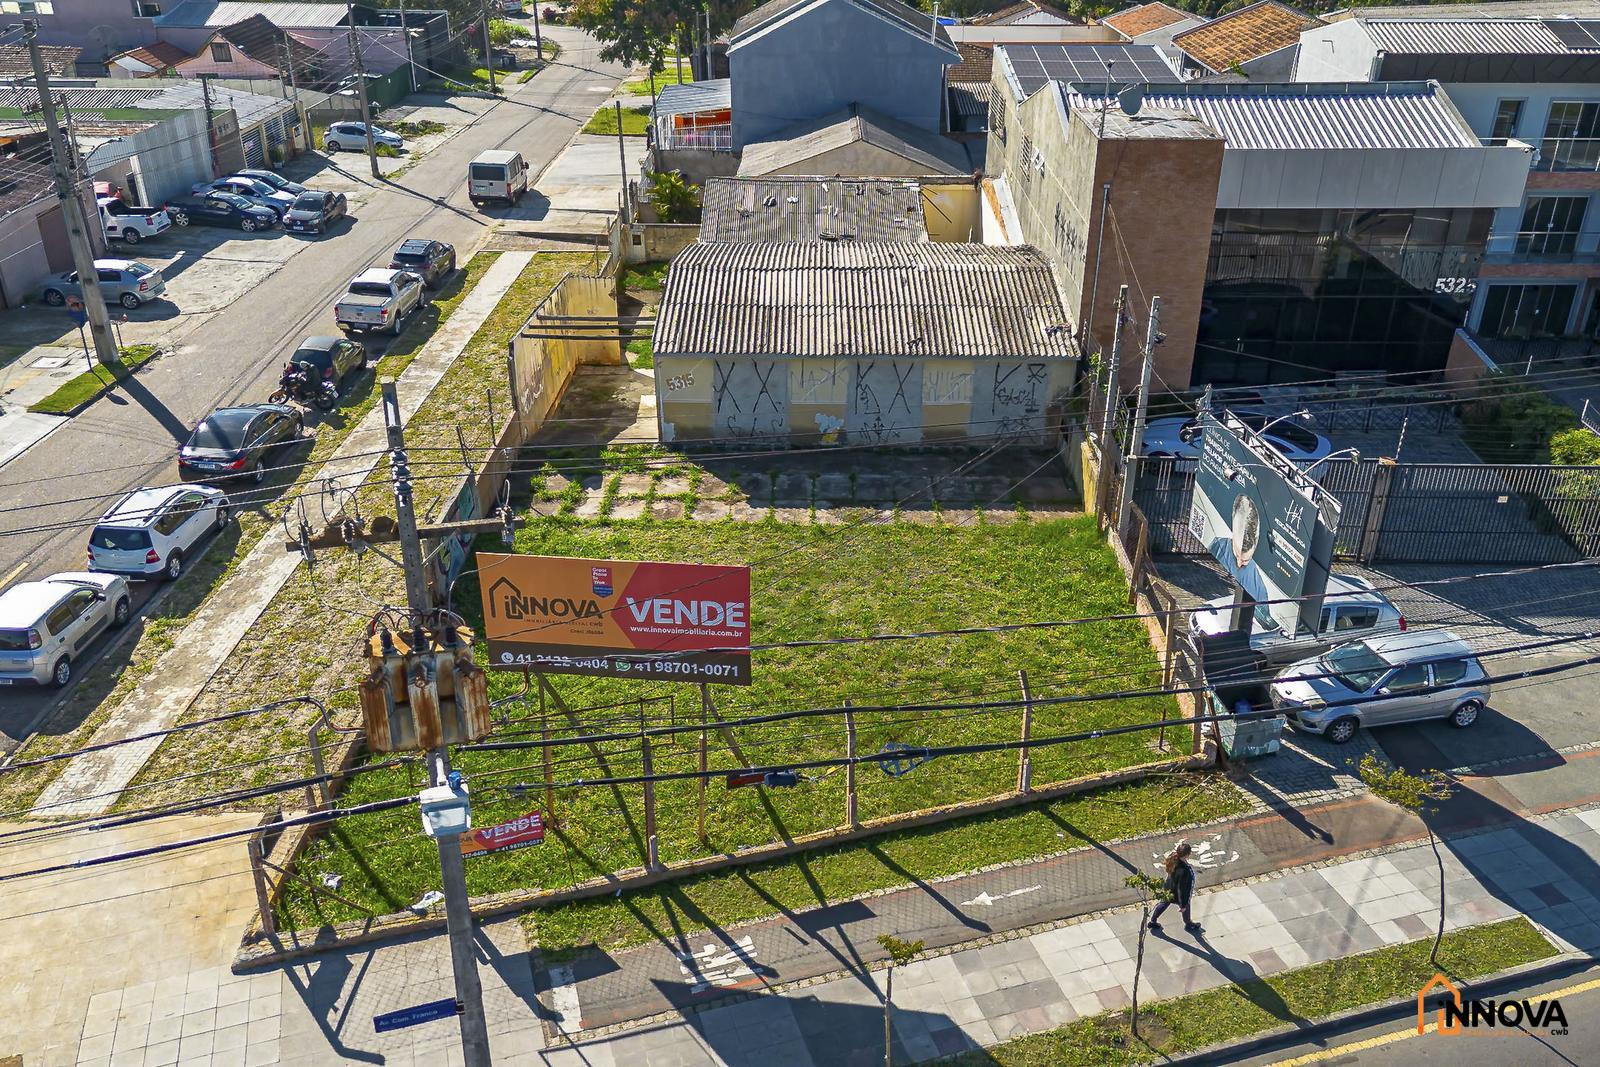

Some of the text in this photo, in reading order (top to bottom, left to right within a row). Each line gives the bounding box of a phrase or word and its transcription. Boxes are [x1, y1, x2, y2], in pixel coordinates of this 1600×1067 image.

[665, 373, 696, 392] 5315
[626, 597, 747, 628] VENDE
[630, 626, 743, 638] www.innovaimobiliaria.com.br
[655, 661, 739, 677] 98701-0071
[481, 814, 541, 839] VENDE
